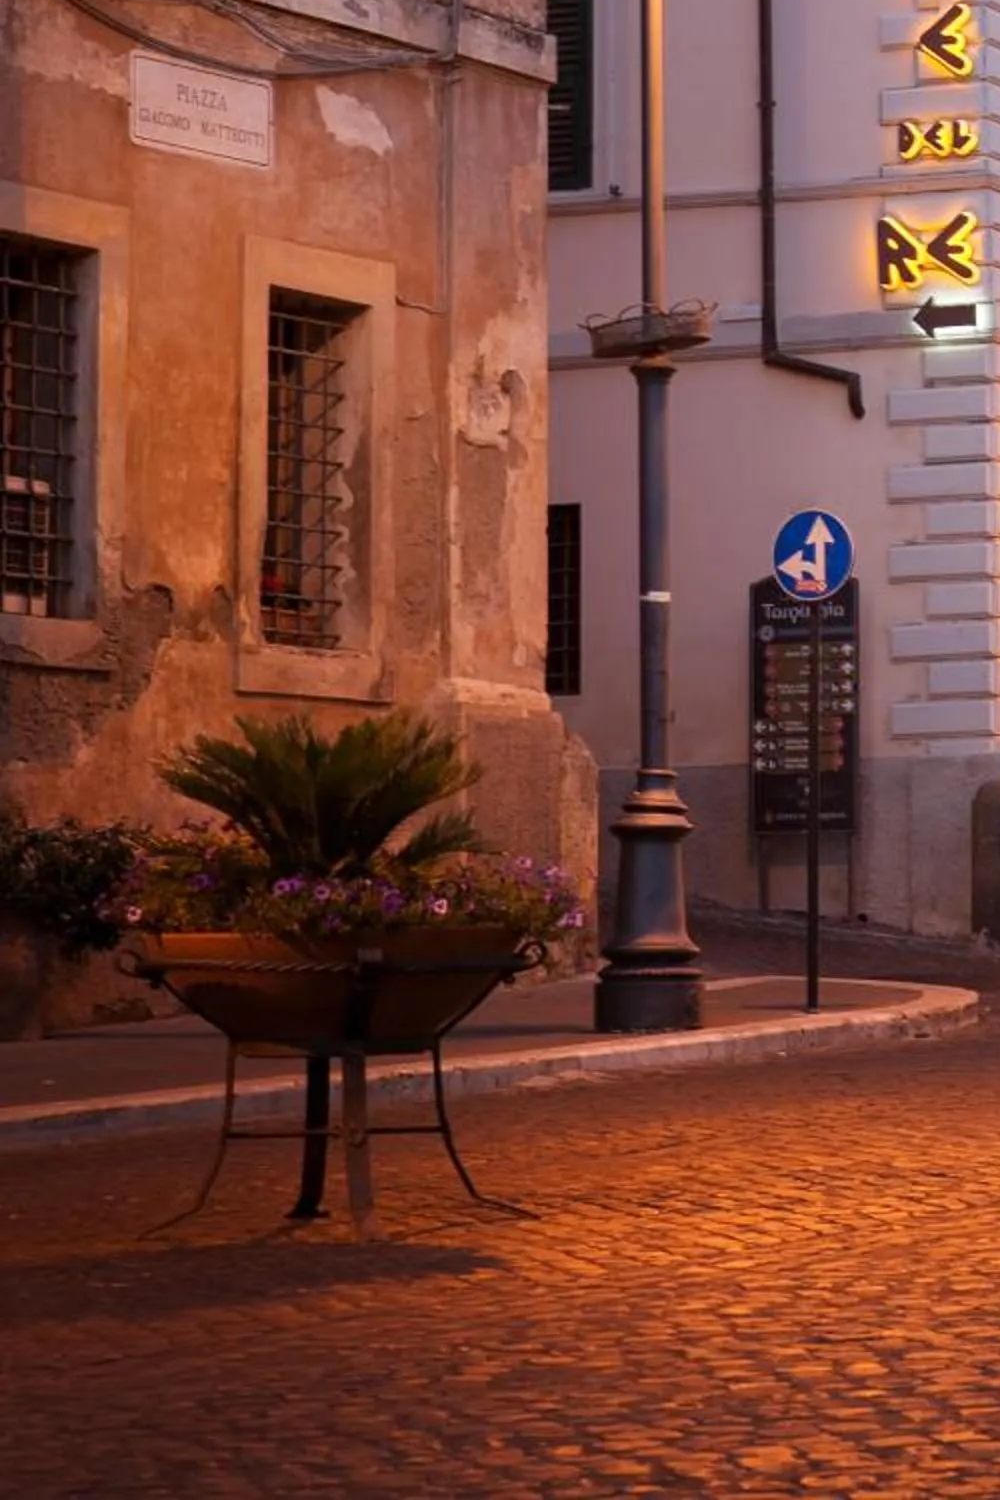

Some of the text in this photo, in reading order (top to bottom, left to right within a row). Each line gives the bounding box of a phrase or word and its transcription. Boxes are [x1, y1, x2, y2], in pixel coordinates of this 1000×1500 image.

[176, 83, 228, 112] PIAZZA
[138, 107, 265, 148] GIACOMO MATTEOTTI
[899, 119, 979, 160] DEL
[877, 211, 981, 291] RE
